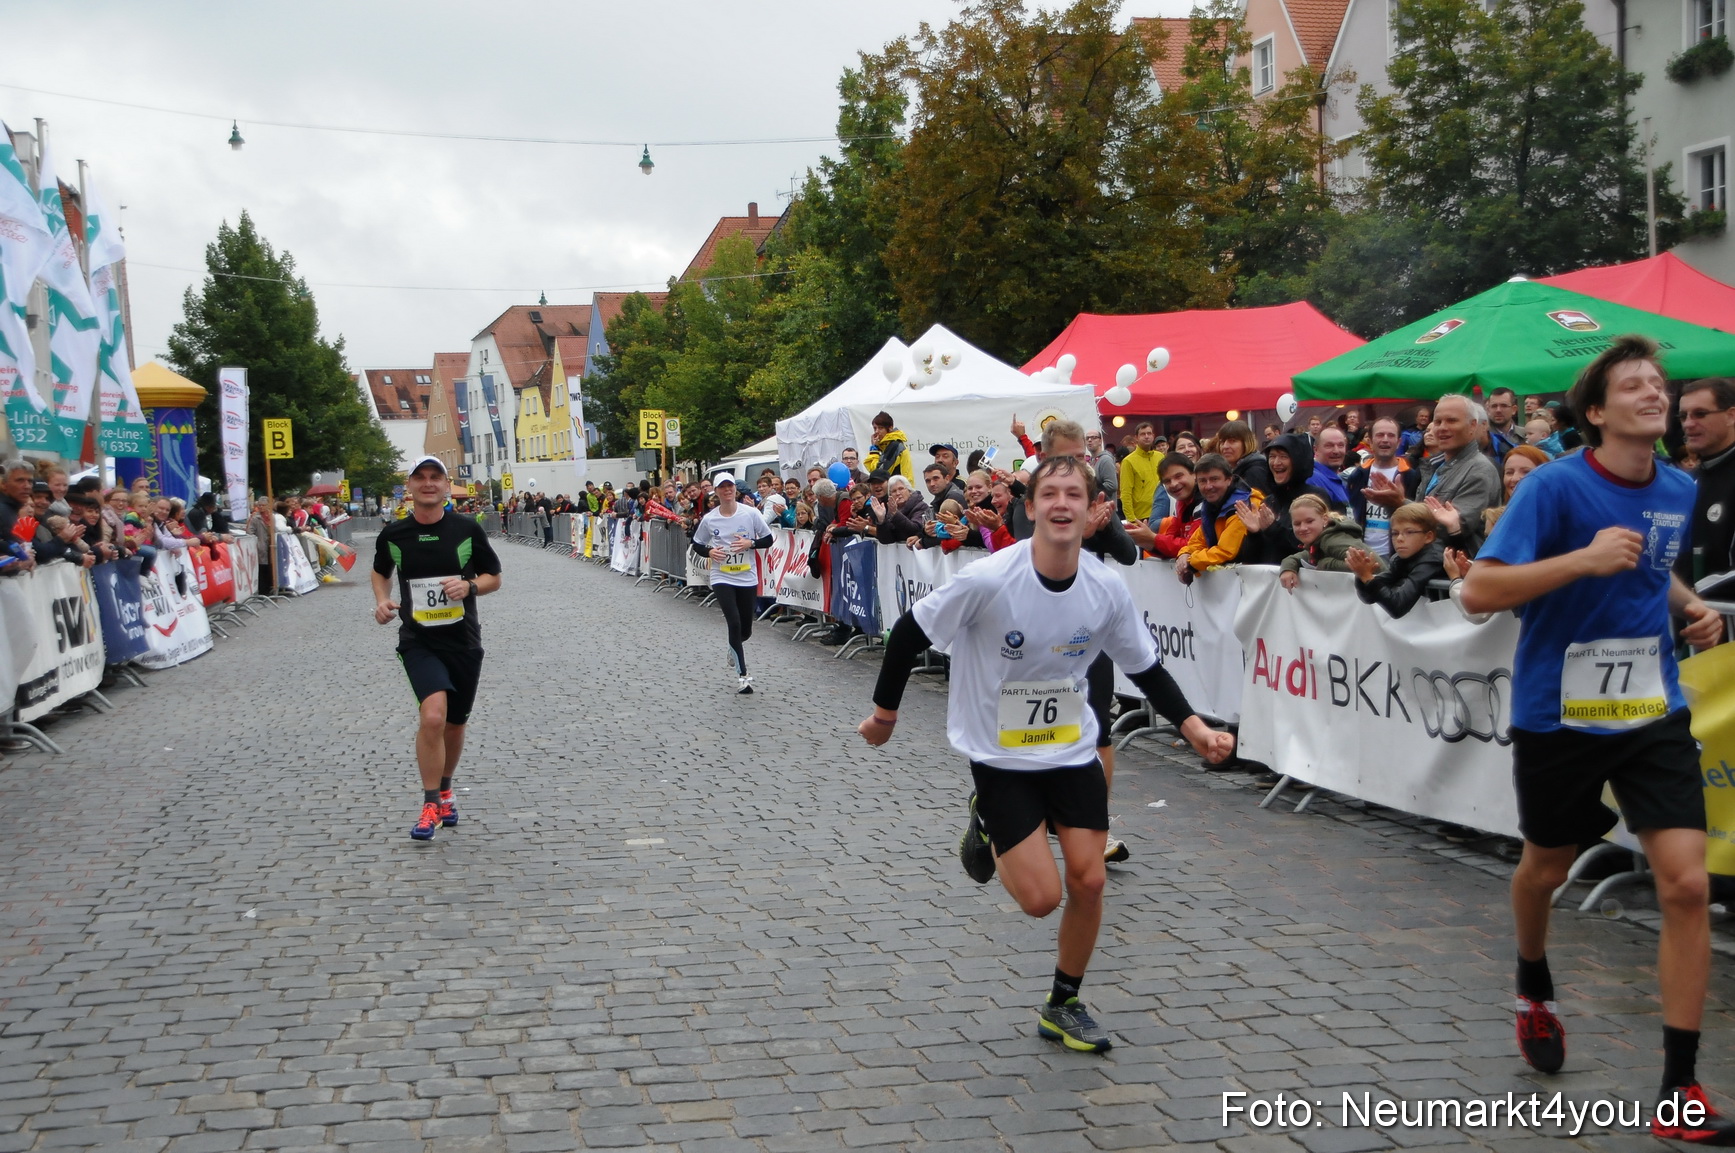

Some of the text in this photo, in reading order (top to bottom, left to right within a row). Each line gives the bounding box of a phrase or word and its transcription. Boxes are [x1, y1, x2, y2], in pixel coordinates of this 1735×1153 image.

[1552, 333, 1616, 347] Neuma
[642, 411, 663, 419] Block
[267, 421, 289, 429] Block
[646, 421, 659, 440] B
[271, 431, 286, 450] B
[977, 435, 1000, 448] Sie.
[110, 441, 140, 454] 6352
[1642, 511, 1653, 519] 12.
[725, 552, 745, 565] 217
[426, 589, 449, 608] 84
[425, 610, 453, 620] Thomas
[1000, 646, 1024, 656] PARTL
[1568, 648, 1645, 659] PARTL Neumarkt
[1252, 637, 1413, 724] Audi BKK
[1595, 661, 1633, 695] 77
[1001, 687, 1070, 696] PARTL Neumarkt
[1025, 697, 1058, 725] 76
[1021, 731, 1056, 744] Jannik
